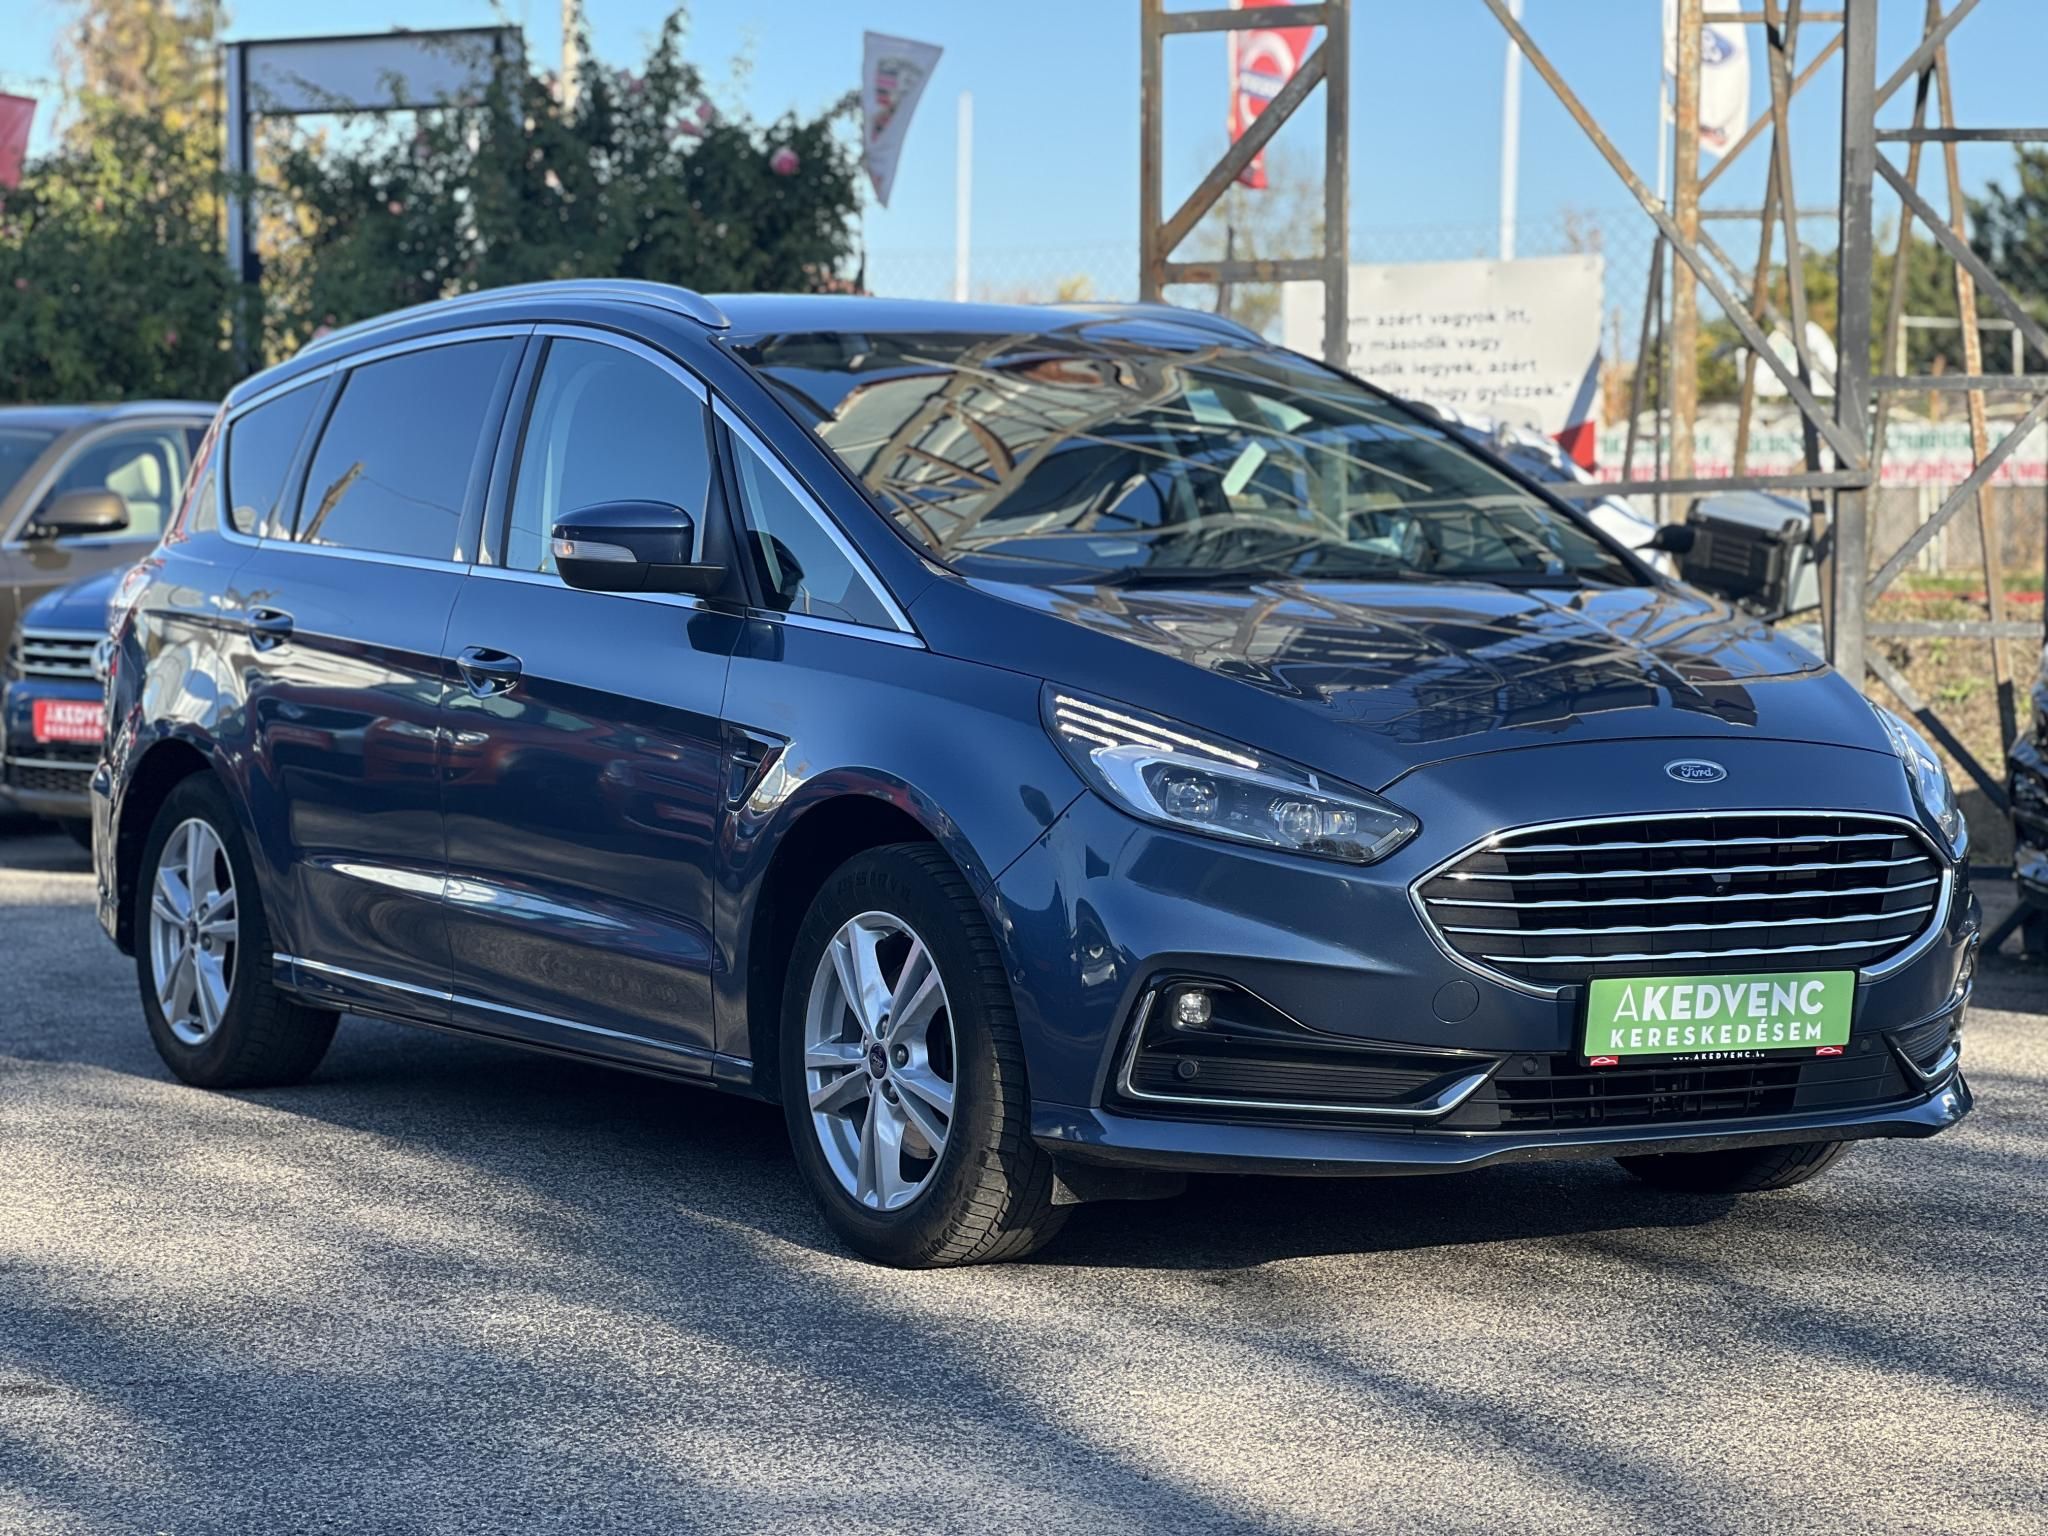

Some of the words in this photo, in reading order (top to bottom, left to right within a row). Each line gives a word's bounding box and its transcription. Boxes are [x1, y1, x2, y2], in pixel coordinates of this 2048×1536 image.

[1457, 337, 1501, 352] vagy
[1680, 764, 1714, 778] Ford
[1613, 979, 1825, 1023] AKEDVENC
[1610, 1019, 1822, 1049] KERESKEDÉSEM
